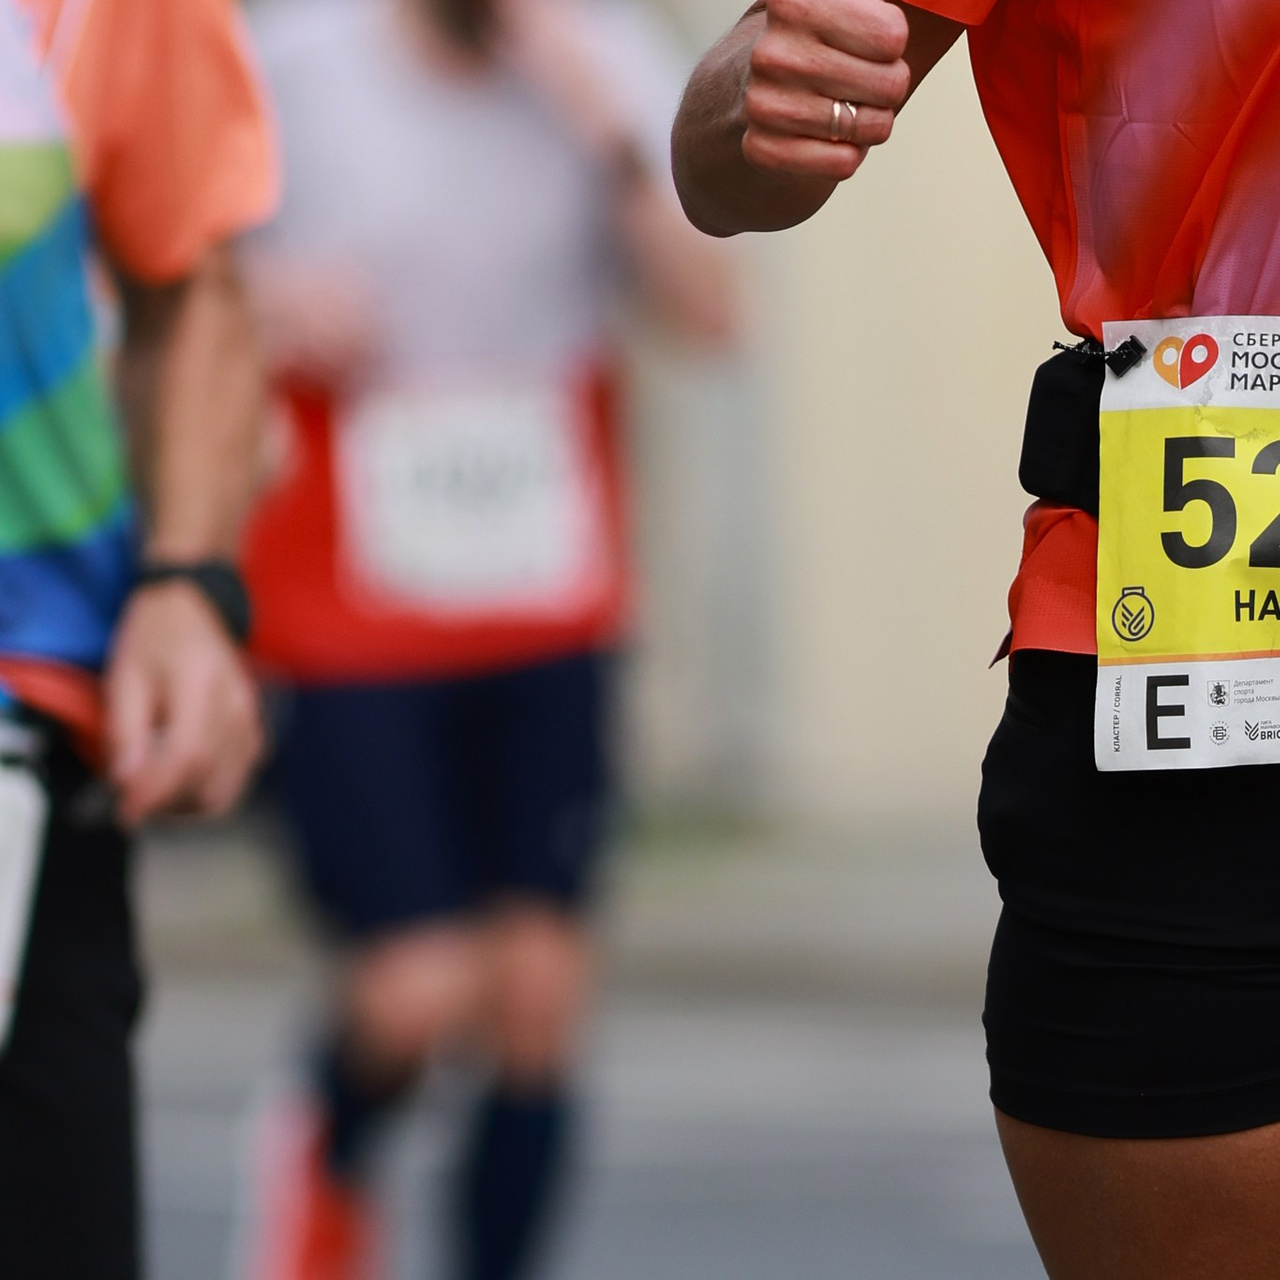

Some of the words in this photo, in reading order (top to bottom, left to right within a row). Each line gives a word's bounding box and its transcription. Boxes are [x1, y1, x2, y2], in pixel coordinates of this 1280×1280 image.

[1113, 675, 1122, 708] CORRAL
[1233, 678, 1274, 687] Департамент
[1146, 674, 1191, 750] E
[1112, 714, 1121, 753] КЛАСТЕР
